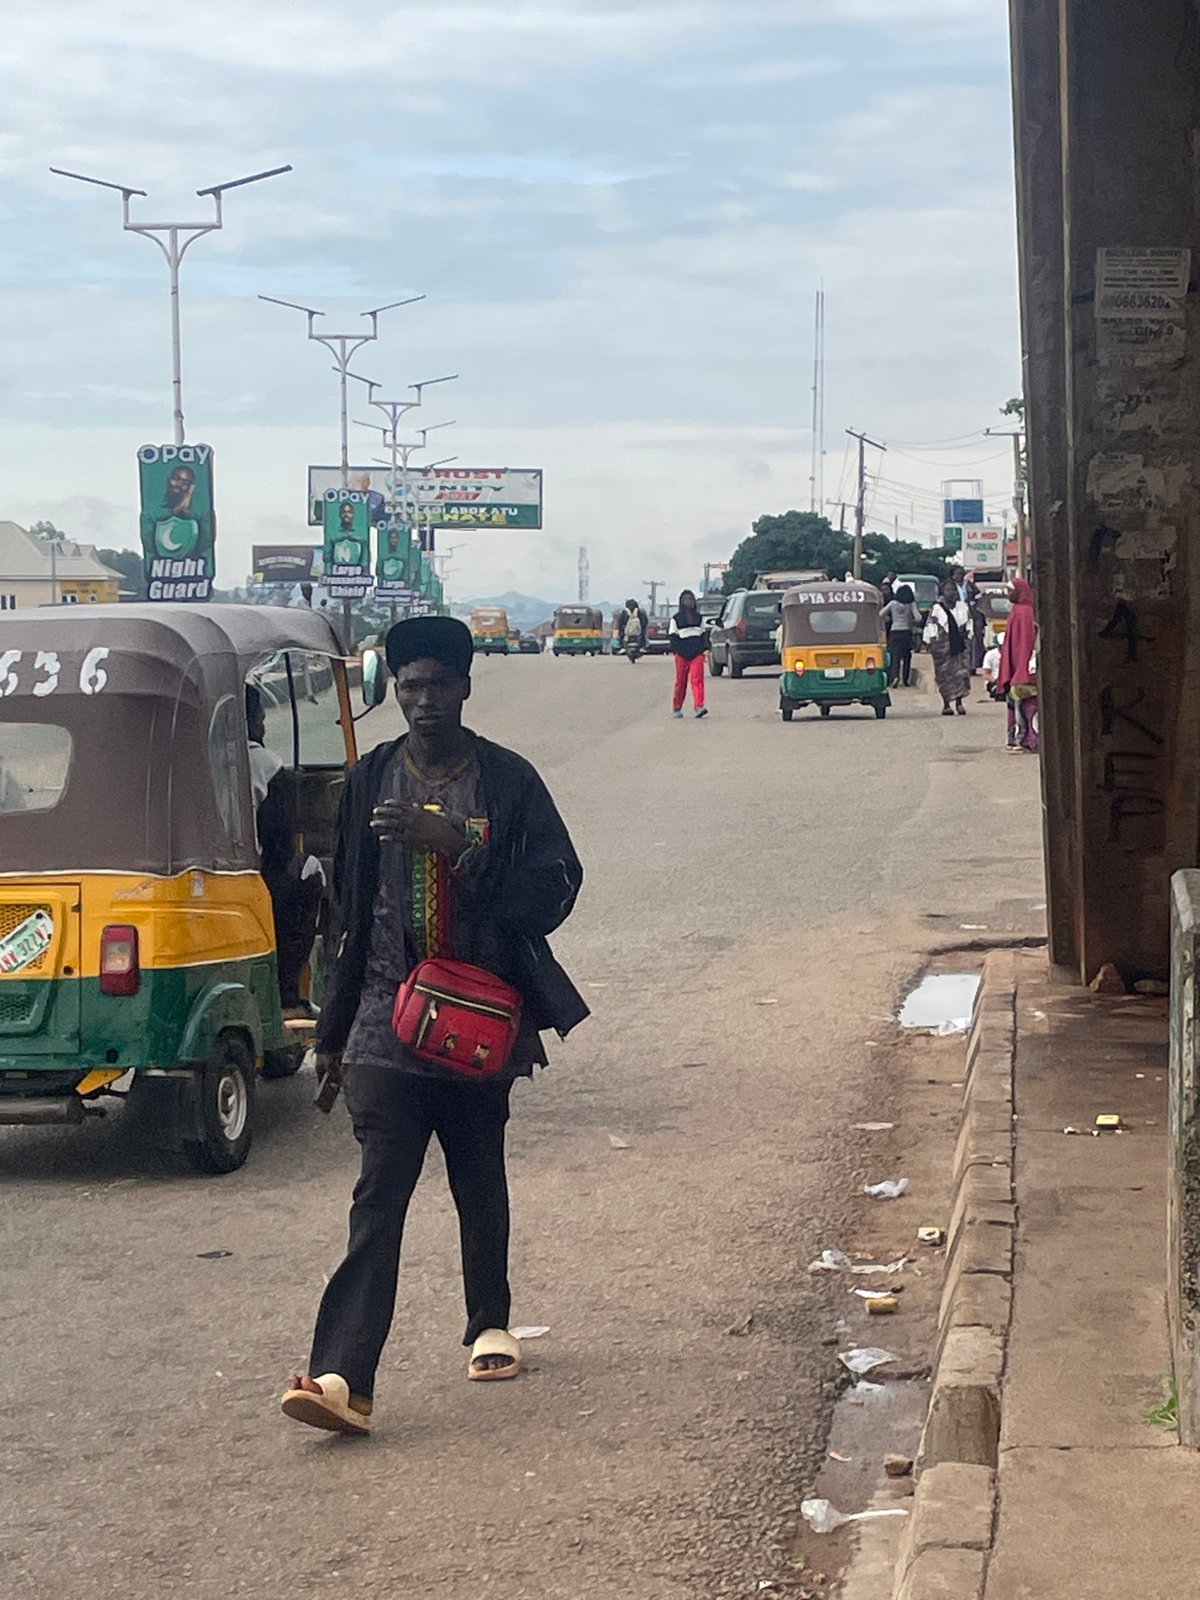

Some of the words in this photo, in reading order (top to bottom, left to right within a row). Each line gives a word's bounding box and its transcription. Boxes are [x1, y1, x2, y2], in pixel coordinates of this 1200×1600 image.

[139, 444, 210, 464] OPay
[422, 470, 504, 479] TRUST
[325, 489, 369, 504] OPay
[151, 558, 205, 578] Night
[150, 579, 209, 600] Guard
[799, 592, 825, 604] PYA
